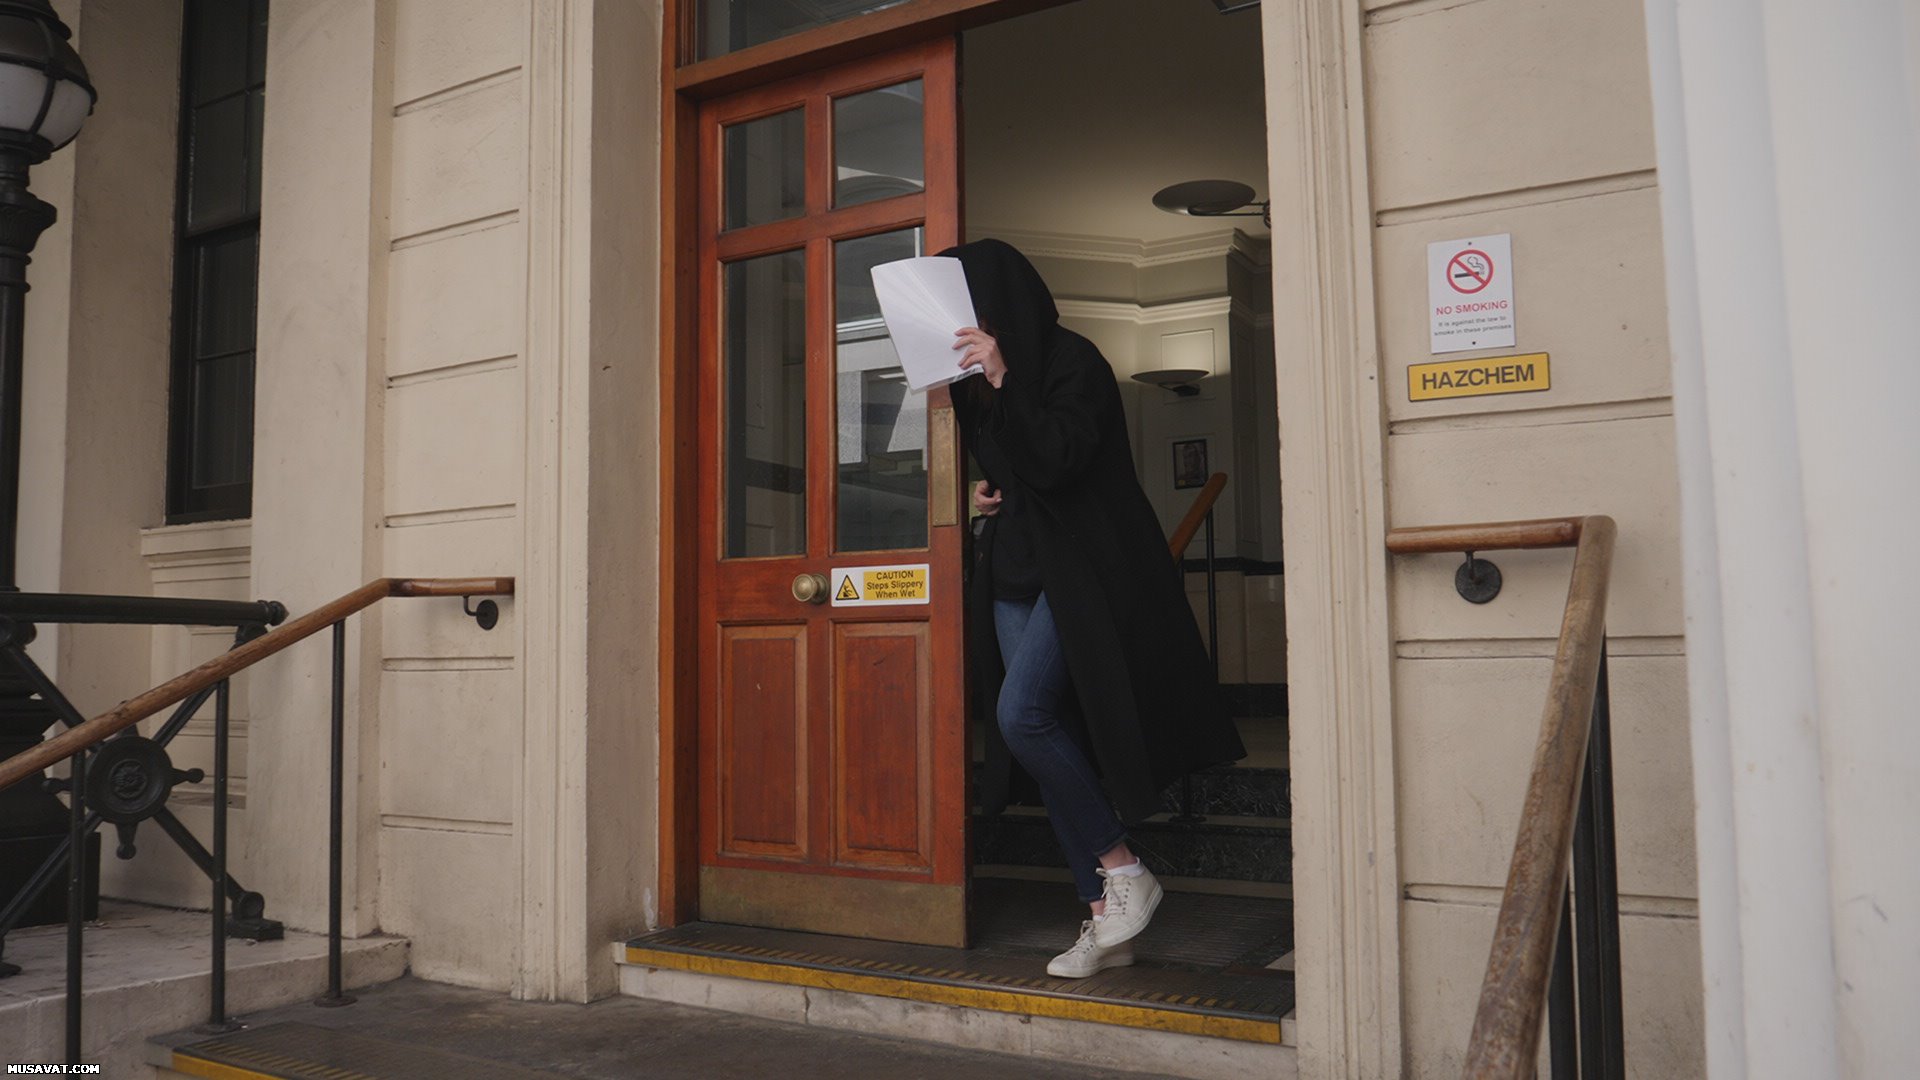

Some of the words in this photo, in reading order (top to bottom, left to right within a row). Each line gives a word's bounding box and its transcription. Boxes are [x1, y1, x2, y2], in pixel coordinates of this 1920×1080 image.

[1436, 306, 1452, 315] NO
[1455, 300, 1508, 314] SMOKING
[1451, 318, 1474, 327] against
[1482, 324, 1512, 333] premises
[1422, 364, 1535, 391] HAZCHEM
[876, 570, 914, 580] CAUTION
[866, 581, 889, 591] Steps
[891, 580, 924, 590] Slippery
[875, 591, 898, 599] When
[899, 589, 916, 598] Wet
